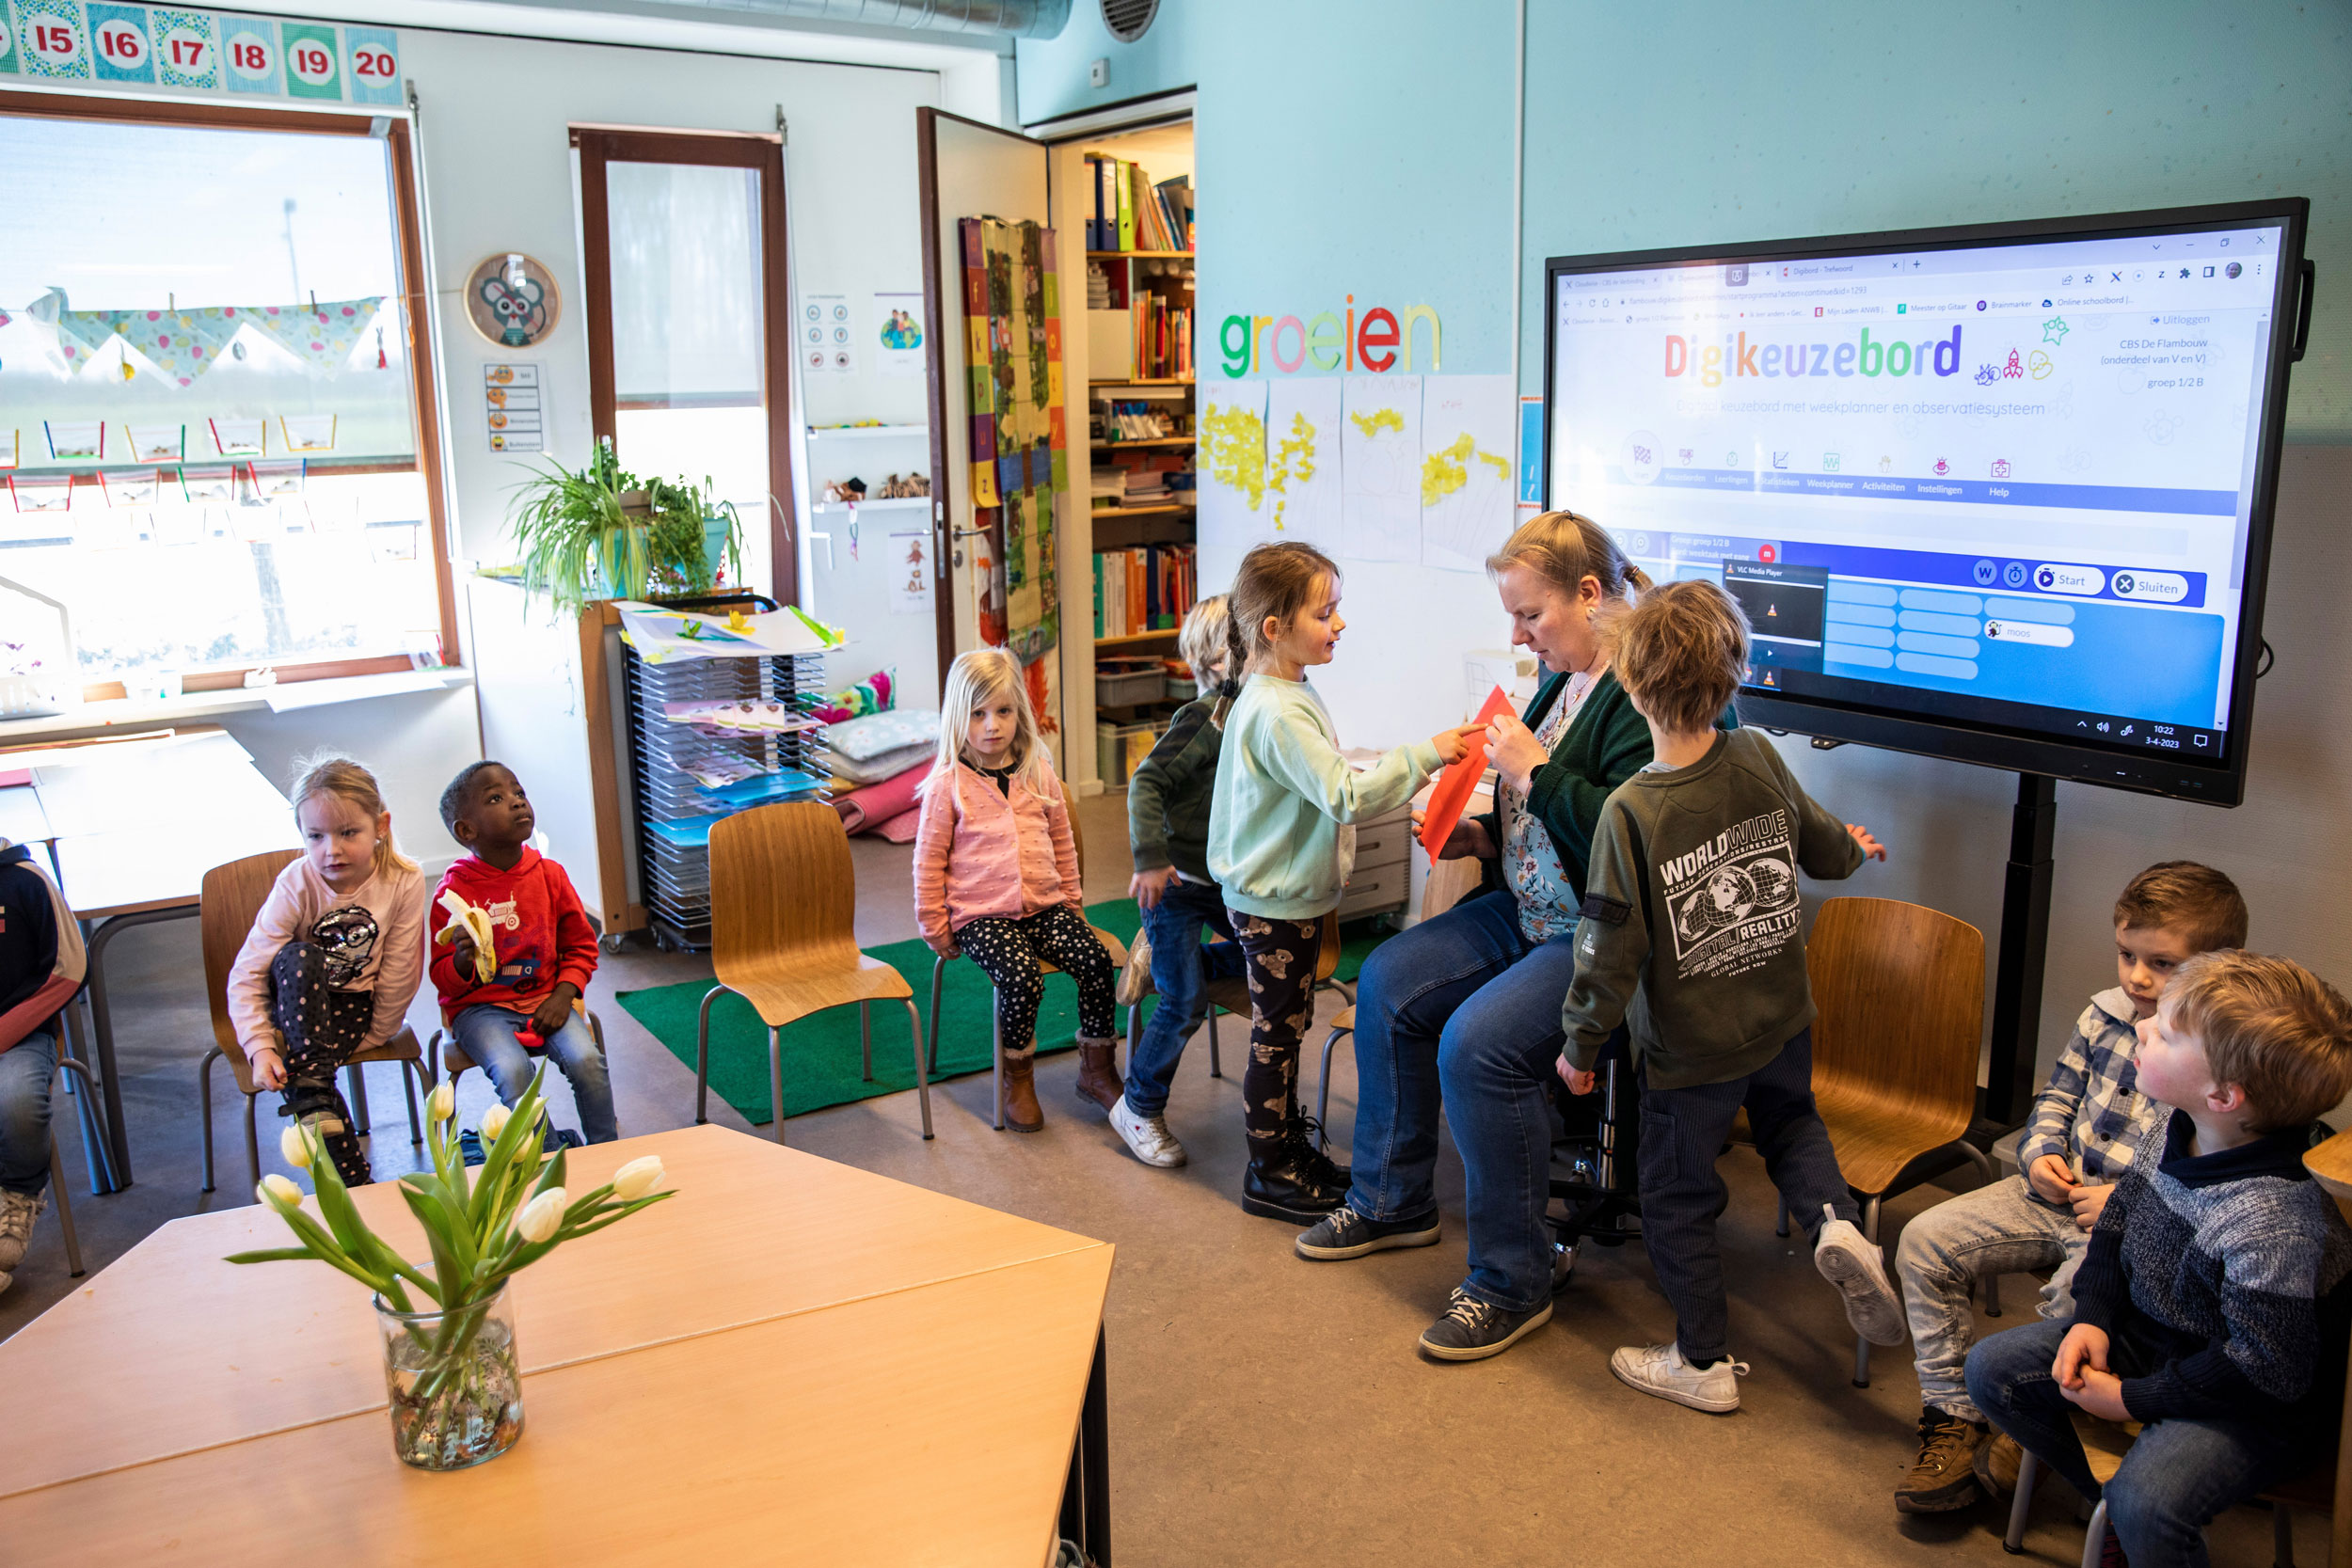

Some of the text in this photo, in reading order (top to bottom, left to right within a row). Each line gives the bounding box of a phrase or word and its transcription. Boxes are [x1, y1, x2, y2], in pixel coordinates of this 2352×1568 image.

[36, 25, 73, 54] 15
[103, 31, 140, 58] 16
[170, 40, 204, 67] 17
[233, 43, 266, 71] 18
[297, 49, 329, 75] 19
[356, 52, 396, 78] 20
[1793, 267, 1818, 276] Digibord
[1992, 300, 2032, 309] Brainmarker
[2058, 295, 2124, 307] Online schoolbord
[1911, 302, 1967, 313] Meester op Gitaar
[2163, 315, 2210, 326] Uitloggen
[1220, 294, 1441, 378] groeien
[2120, 338, 2208, 349] CBS De Flambouw
[1665, 325, 1963, 388] Digikeuzebord
[2101, 355, 2148, 366] (onderdeel
[2170, 356, 2180, 364] V
[2195, 354, 2206, 365] V)
[2148, 377, 2204, 389] groep 1/2 B
[1721, 400, 1780, 413] keuzebord
[1783, 401, 1806, 413] met
[1810, 400, 1888, 416] weekplanner
[1893, 404, 1909, 414] en
[1913, 401, 2045, 418] observatiesysteem
[1760, 476, 1800, 487] Statistieken
[1806, 478, 1854, 492] Weekplanner
[1862, 481, 1905, 493] Activiteiten
[1917, 484, 1963, 496] Instellingen
[1989, 487, 2010, 499] Help
[1766, 569, 1783, 578] Player
[1978, 566, 1993, 578] W
[2058, 574, 2086, 587] Start
[2138, 580, 2179, 594] Sluiten
[2007, 629, 2031, 639] moos
[2153, 724, 2174, 736] 10:22
[2145, 736, 2180, 749] 3-4-2023
[1660, 809, 1788, 887] WORLDWIDE
[1663, 878, 1695, 895] FUTURE
[1710, 961, 1739, 978] GLOBAL
[1740, 947, 1783, 965] NETWORKS
